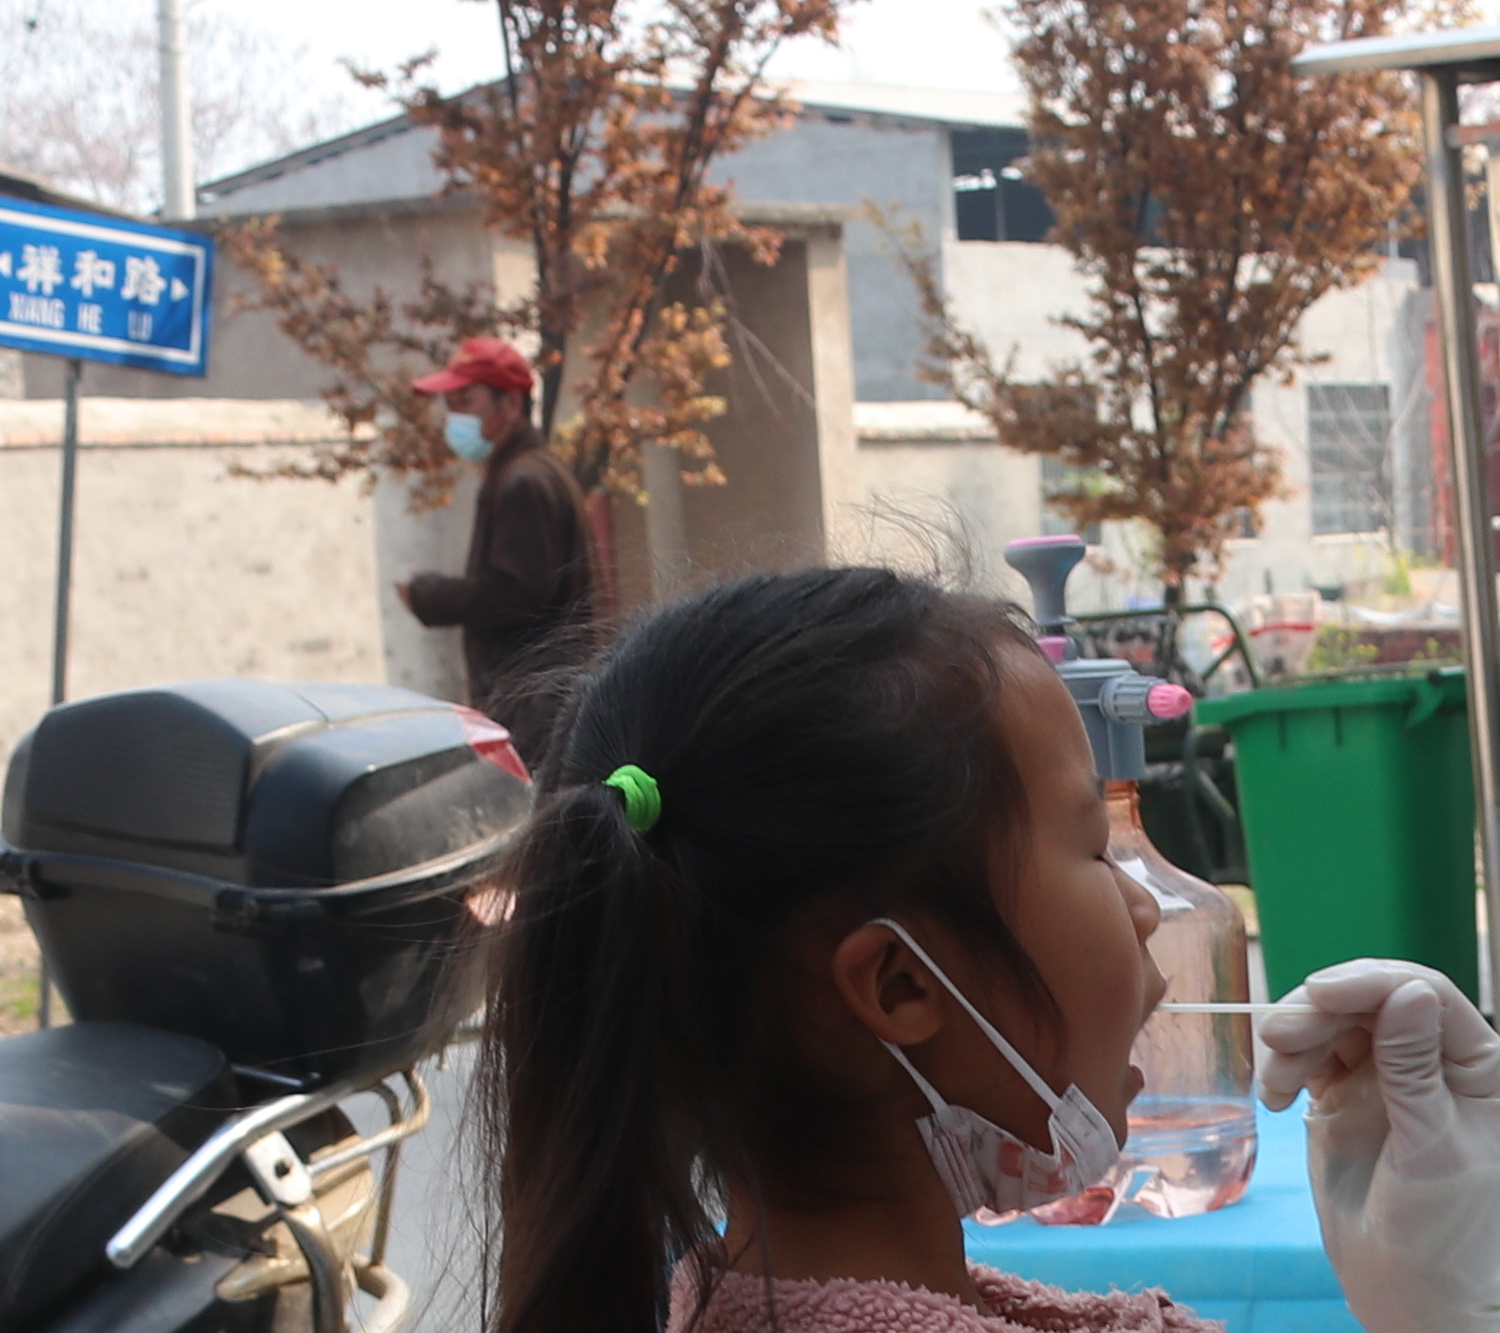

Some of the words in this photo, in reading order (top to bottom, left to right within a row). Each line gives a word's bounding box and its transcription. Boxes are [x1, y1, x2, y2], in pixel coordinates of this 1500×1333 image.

[16, 243, 168, 307] 祥和路
[8, 290, 66, 330] XIANG
[77, 301, 103, 335] HE
[127, 310, 152, 342] LU
